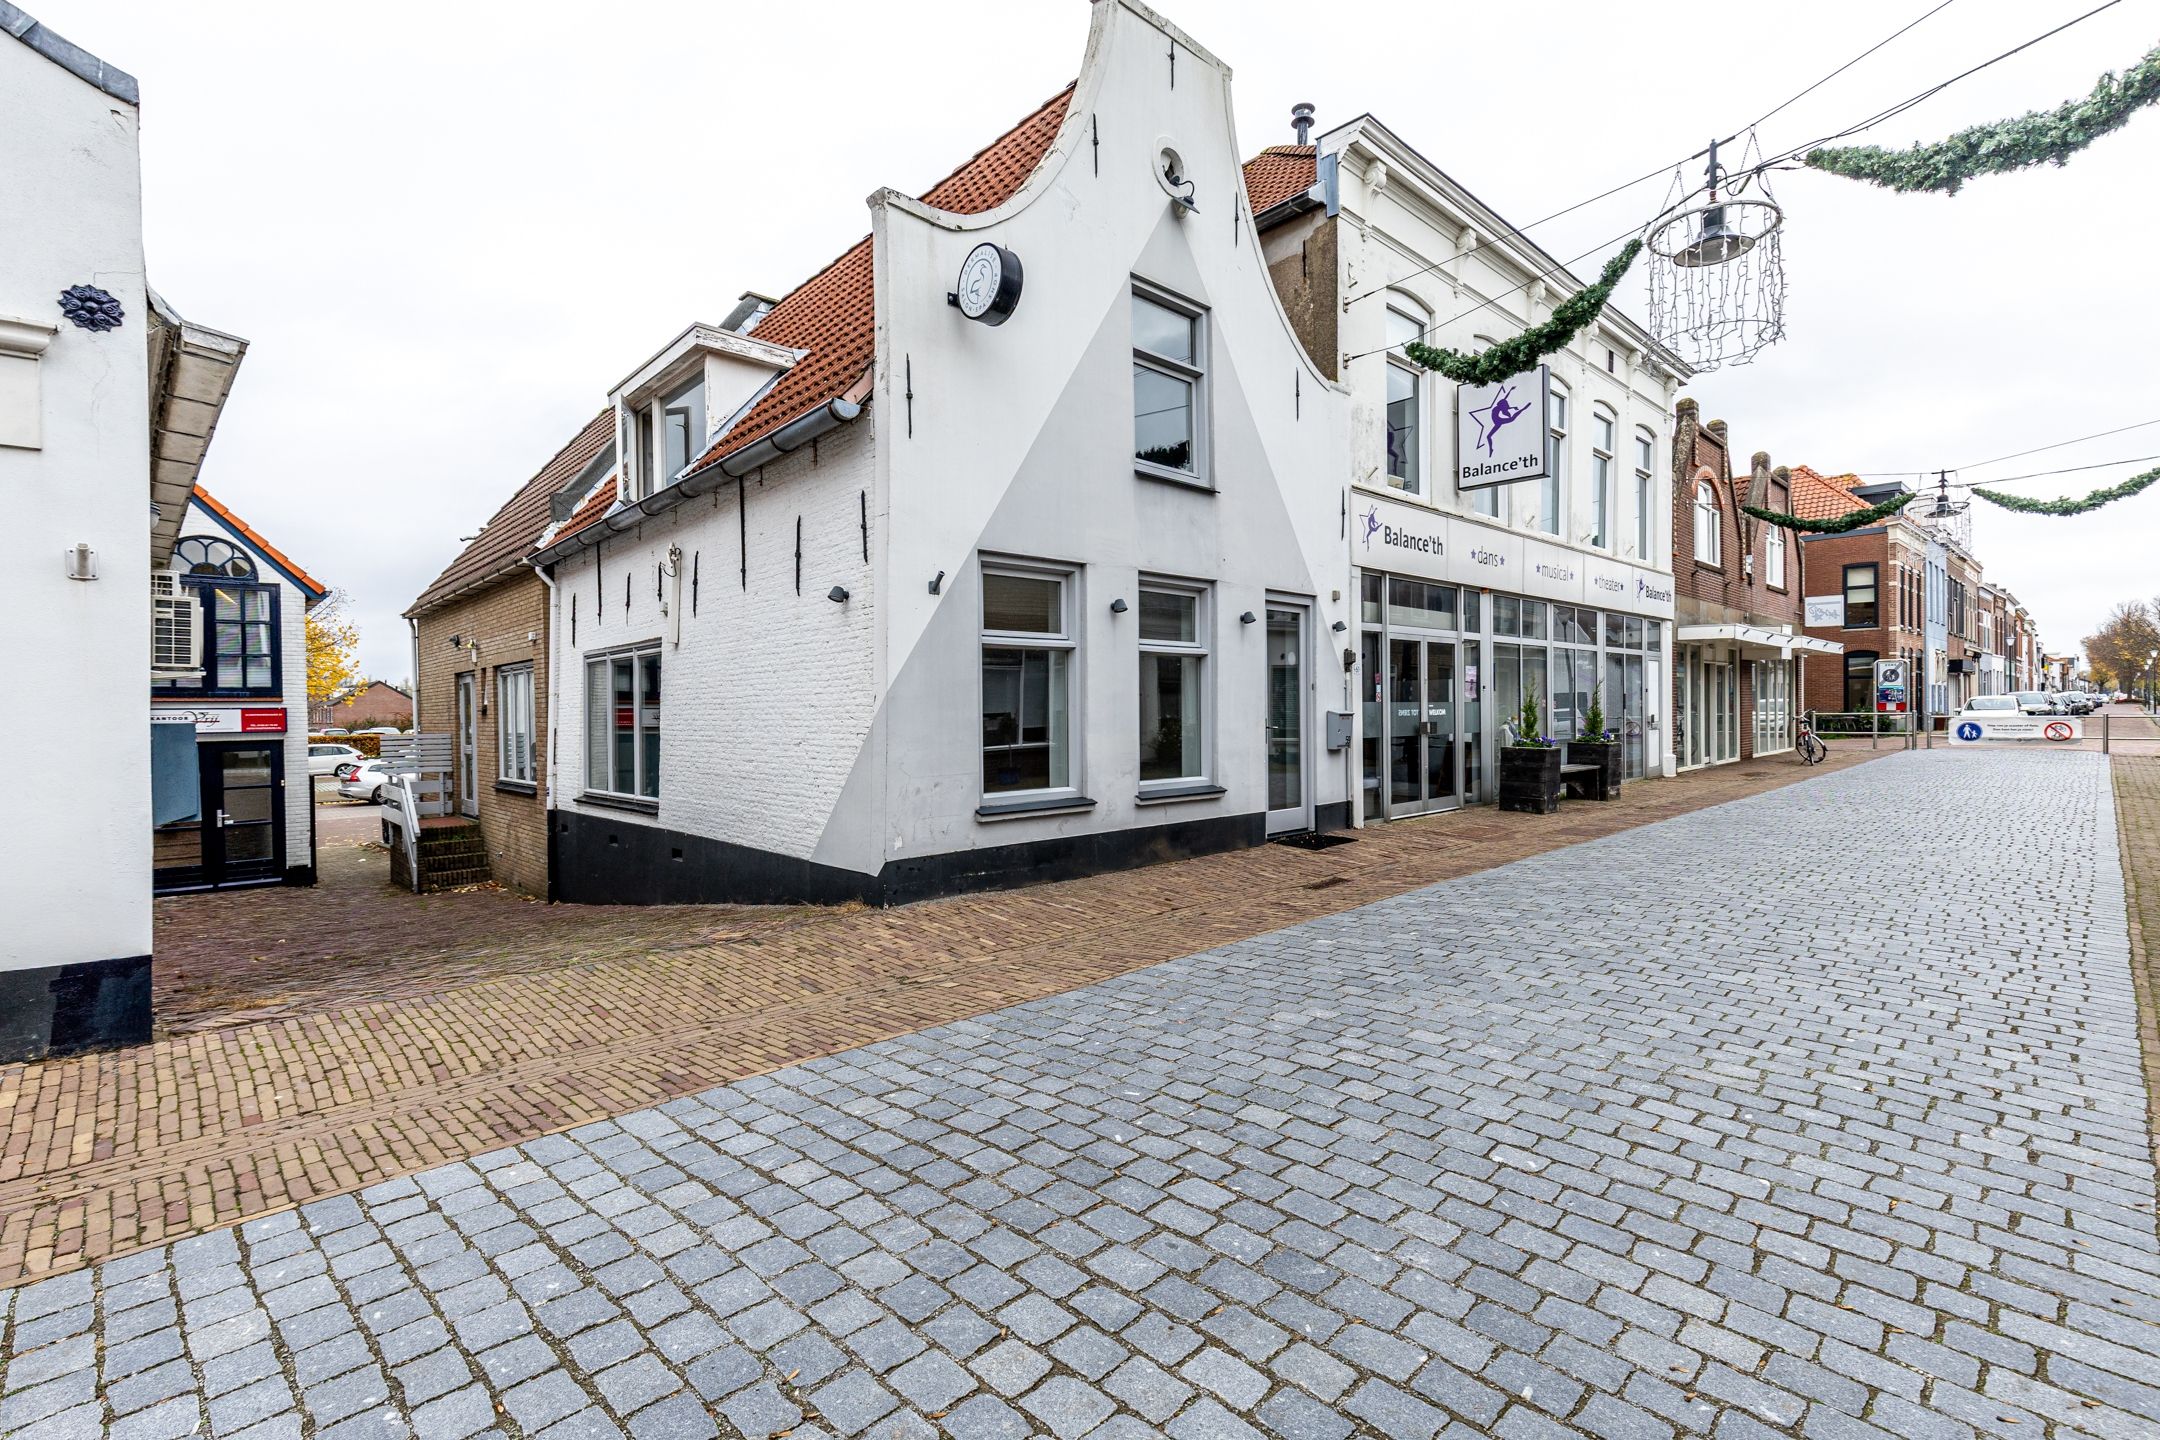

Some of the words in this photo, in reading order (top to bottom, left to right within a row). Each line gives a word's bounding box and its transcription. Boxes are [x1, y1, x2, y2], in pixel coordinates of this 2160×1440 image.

[1463, 454, 1538, 478] Balance'th
[1384, 525, 1444, 556] Balance'th
[1477, 546, 1498, 567] dans
[1541, 564, 1569, 582] musical
[1598, 574, 1620, 592] theater
[1645, 585, 1672, 603] Balance'th
